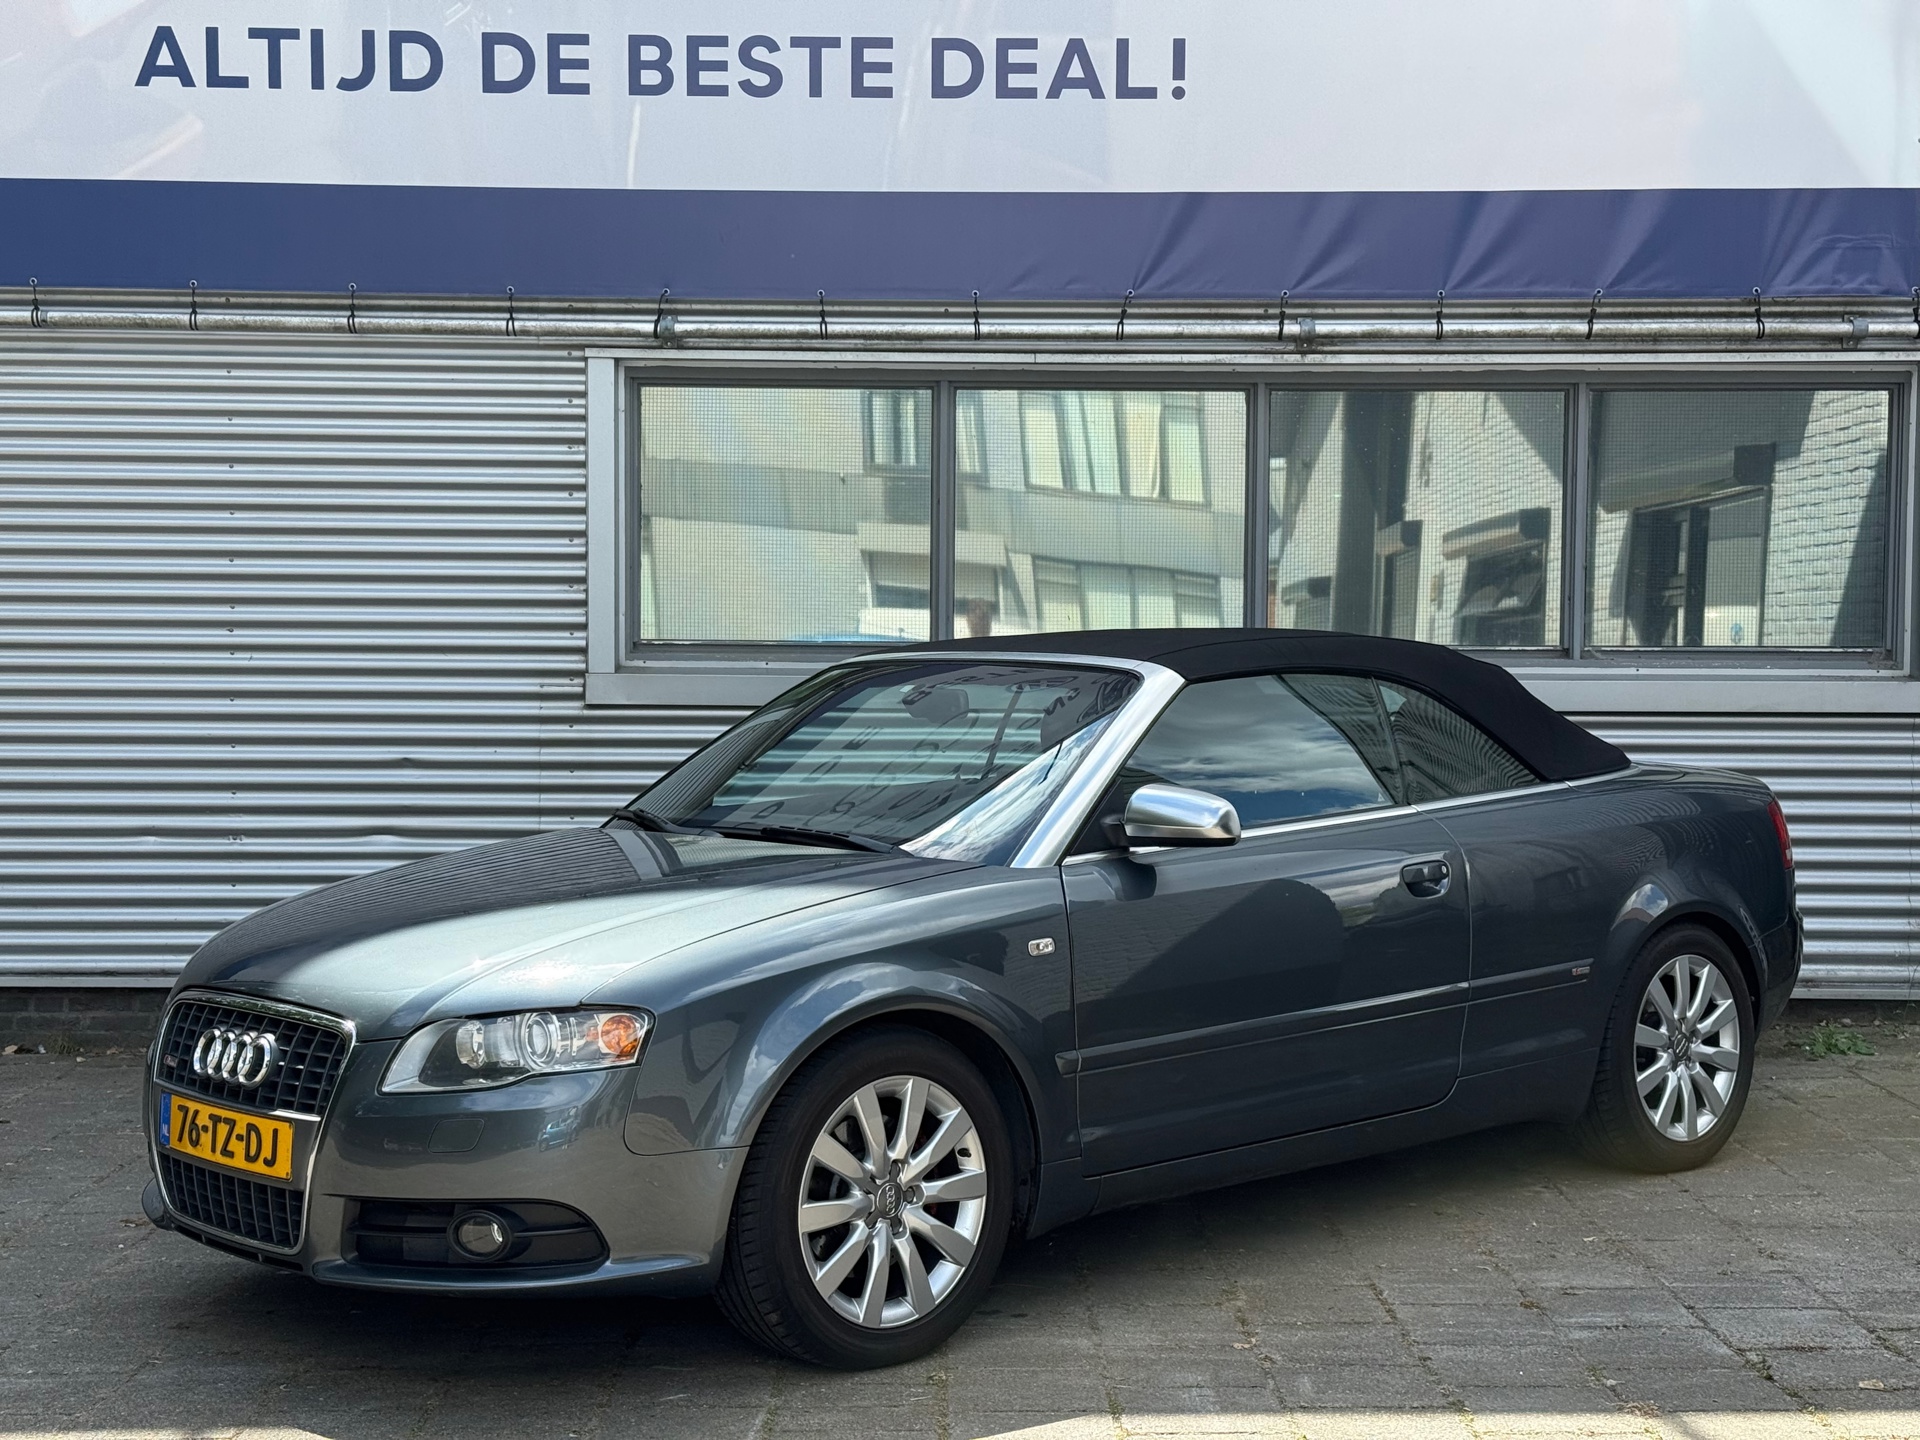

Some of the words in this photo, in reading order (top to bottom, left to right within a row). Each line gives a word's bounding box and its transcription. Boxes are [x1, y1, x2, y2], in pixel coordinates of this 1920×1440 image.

[134, 25, 444, 92] ALTIJD
[481, 31, 591, 95] DE
[627, 34, 894, 98] BESTE
[930, 37, 1187, 100] DEAL!
[177, 1104, 279, 1168] 76-TZ-DJ
